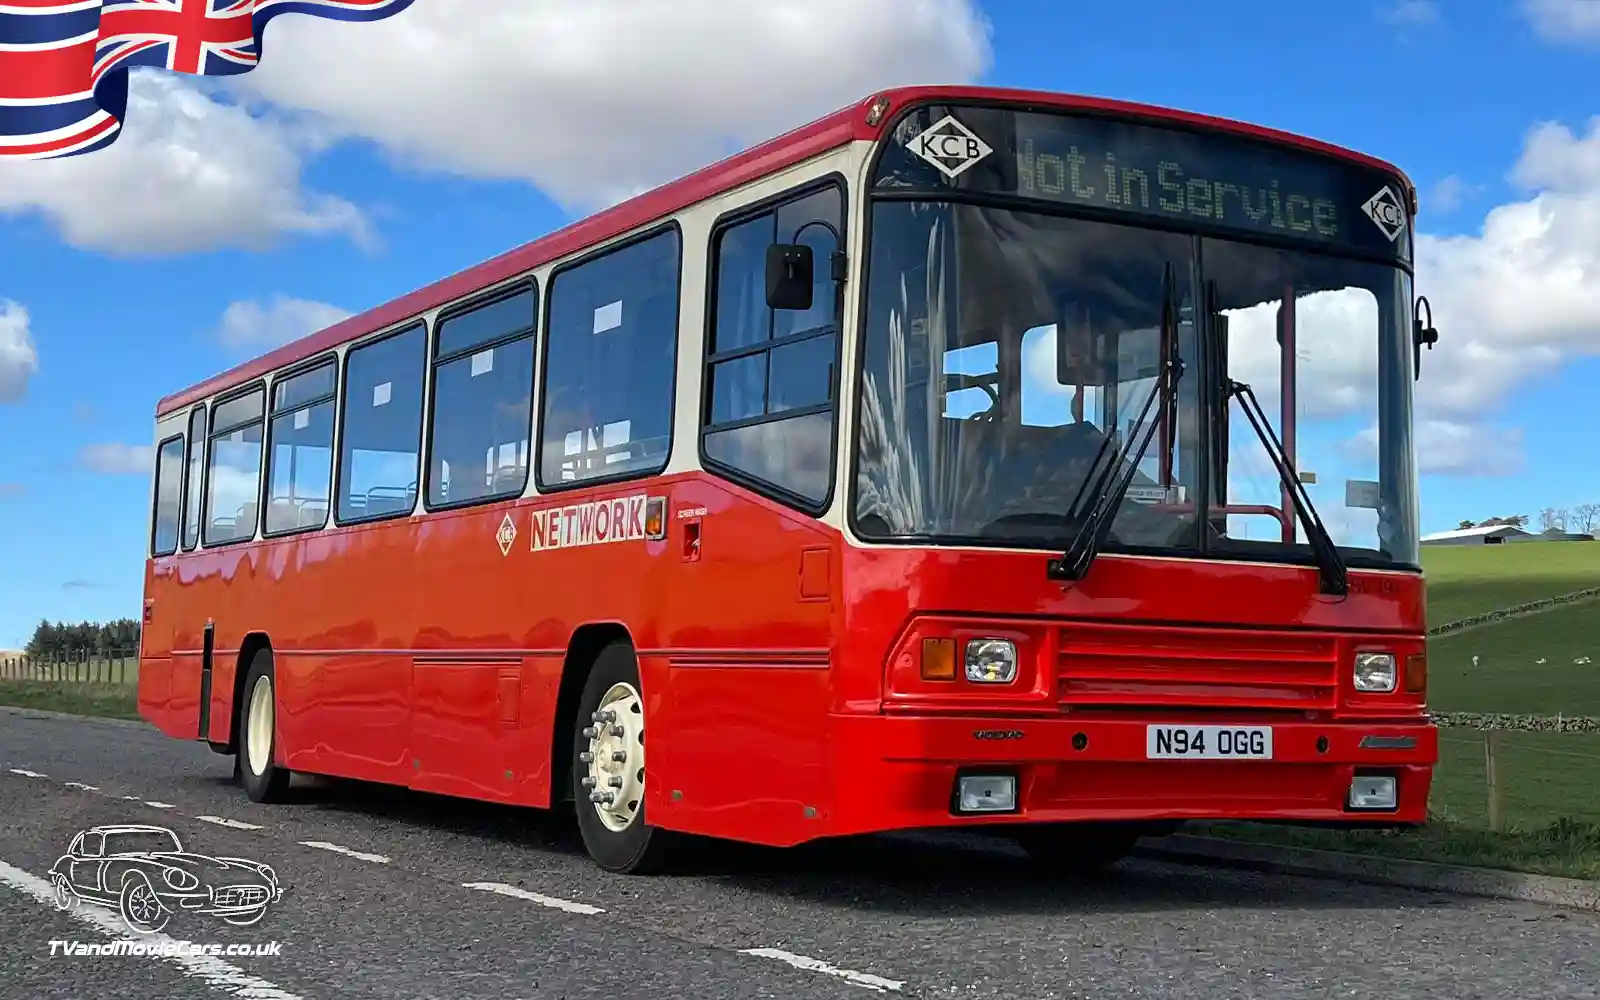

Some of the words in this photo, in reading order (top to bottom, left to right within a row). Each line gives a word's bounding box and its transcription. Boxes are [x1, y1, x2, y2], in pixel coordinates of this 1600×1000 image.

[920, 135, 980, 159] KCB
[1103, 151, 1150, 208] in
[1157, 160, 1338, 236] Service
[532, 499, 643, 549] NETWORK
[1156, 728, 1205, 754] N94
[1217, 730, 1264, 755] OGG
